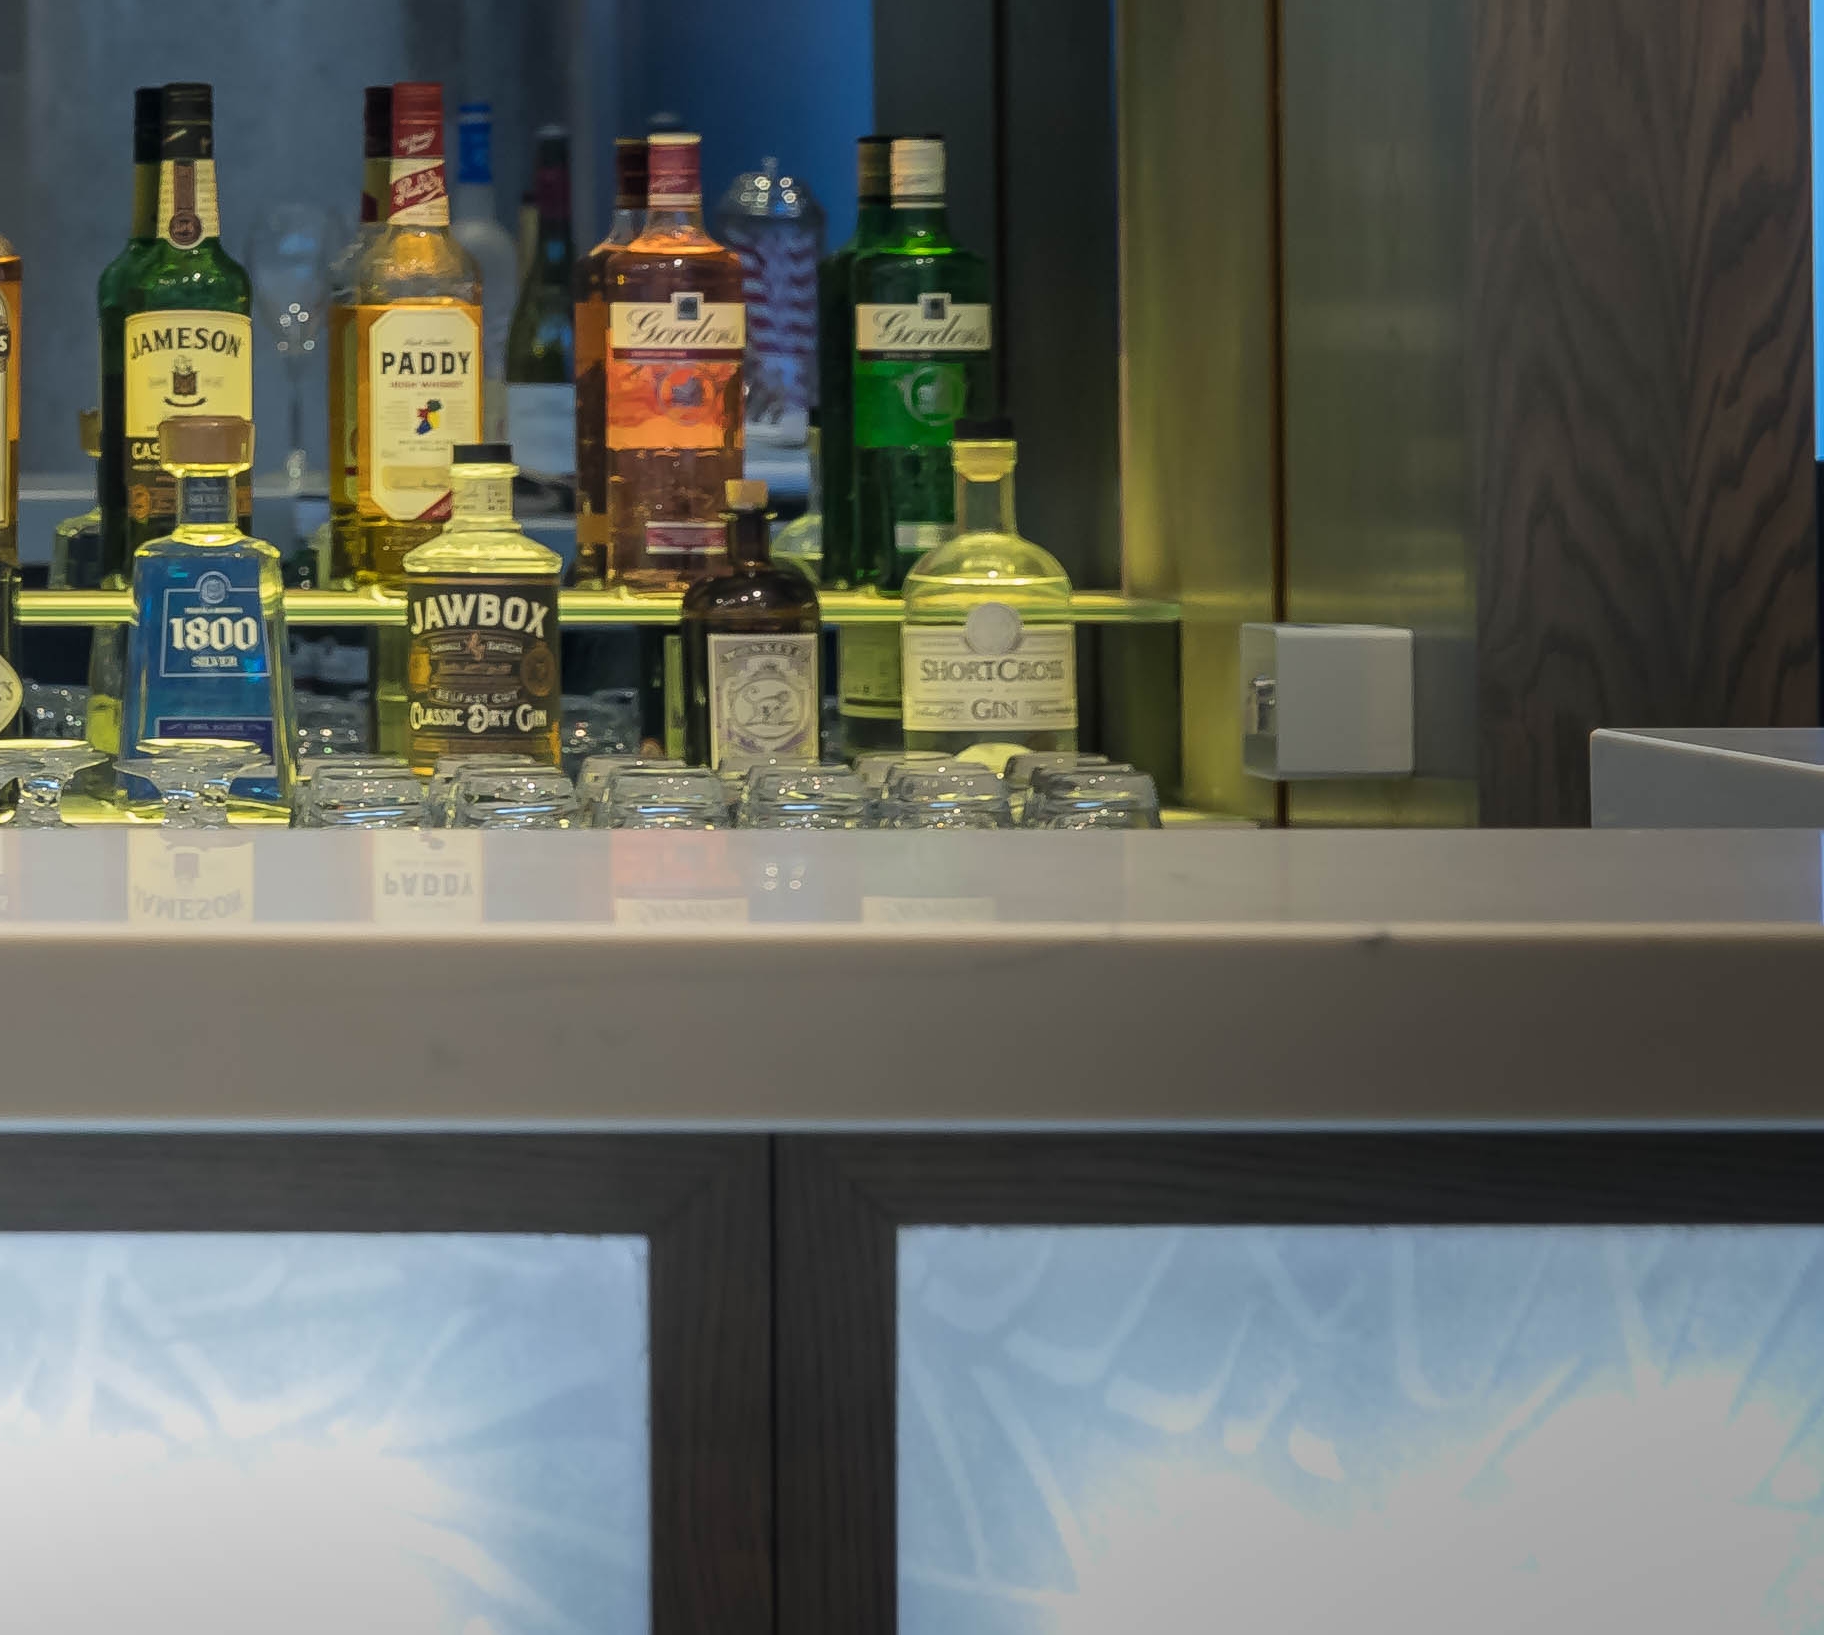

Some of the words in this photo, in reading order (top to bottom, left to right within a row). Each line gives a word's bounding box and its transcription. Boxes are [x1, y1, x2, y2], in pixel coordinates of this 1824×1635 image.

[131, 327, 241, 359] JAMESON
[380, 351, 472, 375] PADDY
[410, 593, 549, 639] JAWBOX
[169, 617, 258, 651] 1800
[971, 698, 1018, 721] GIN
